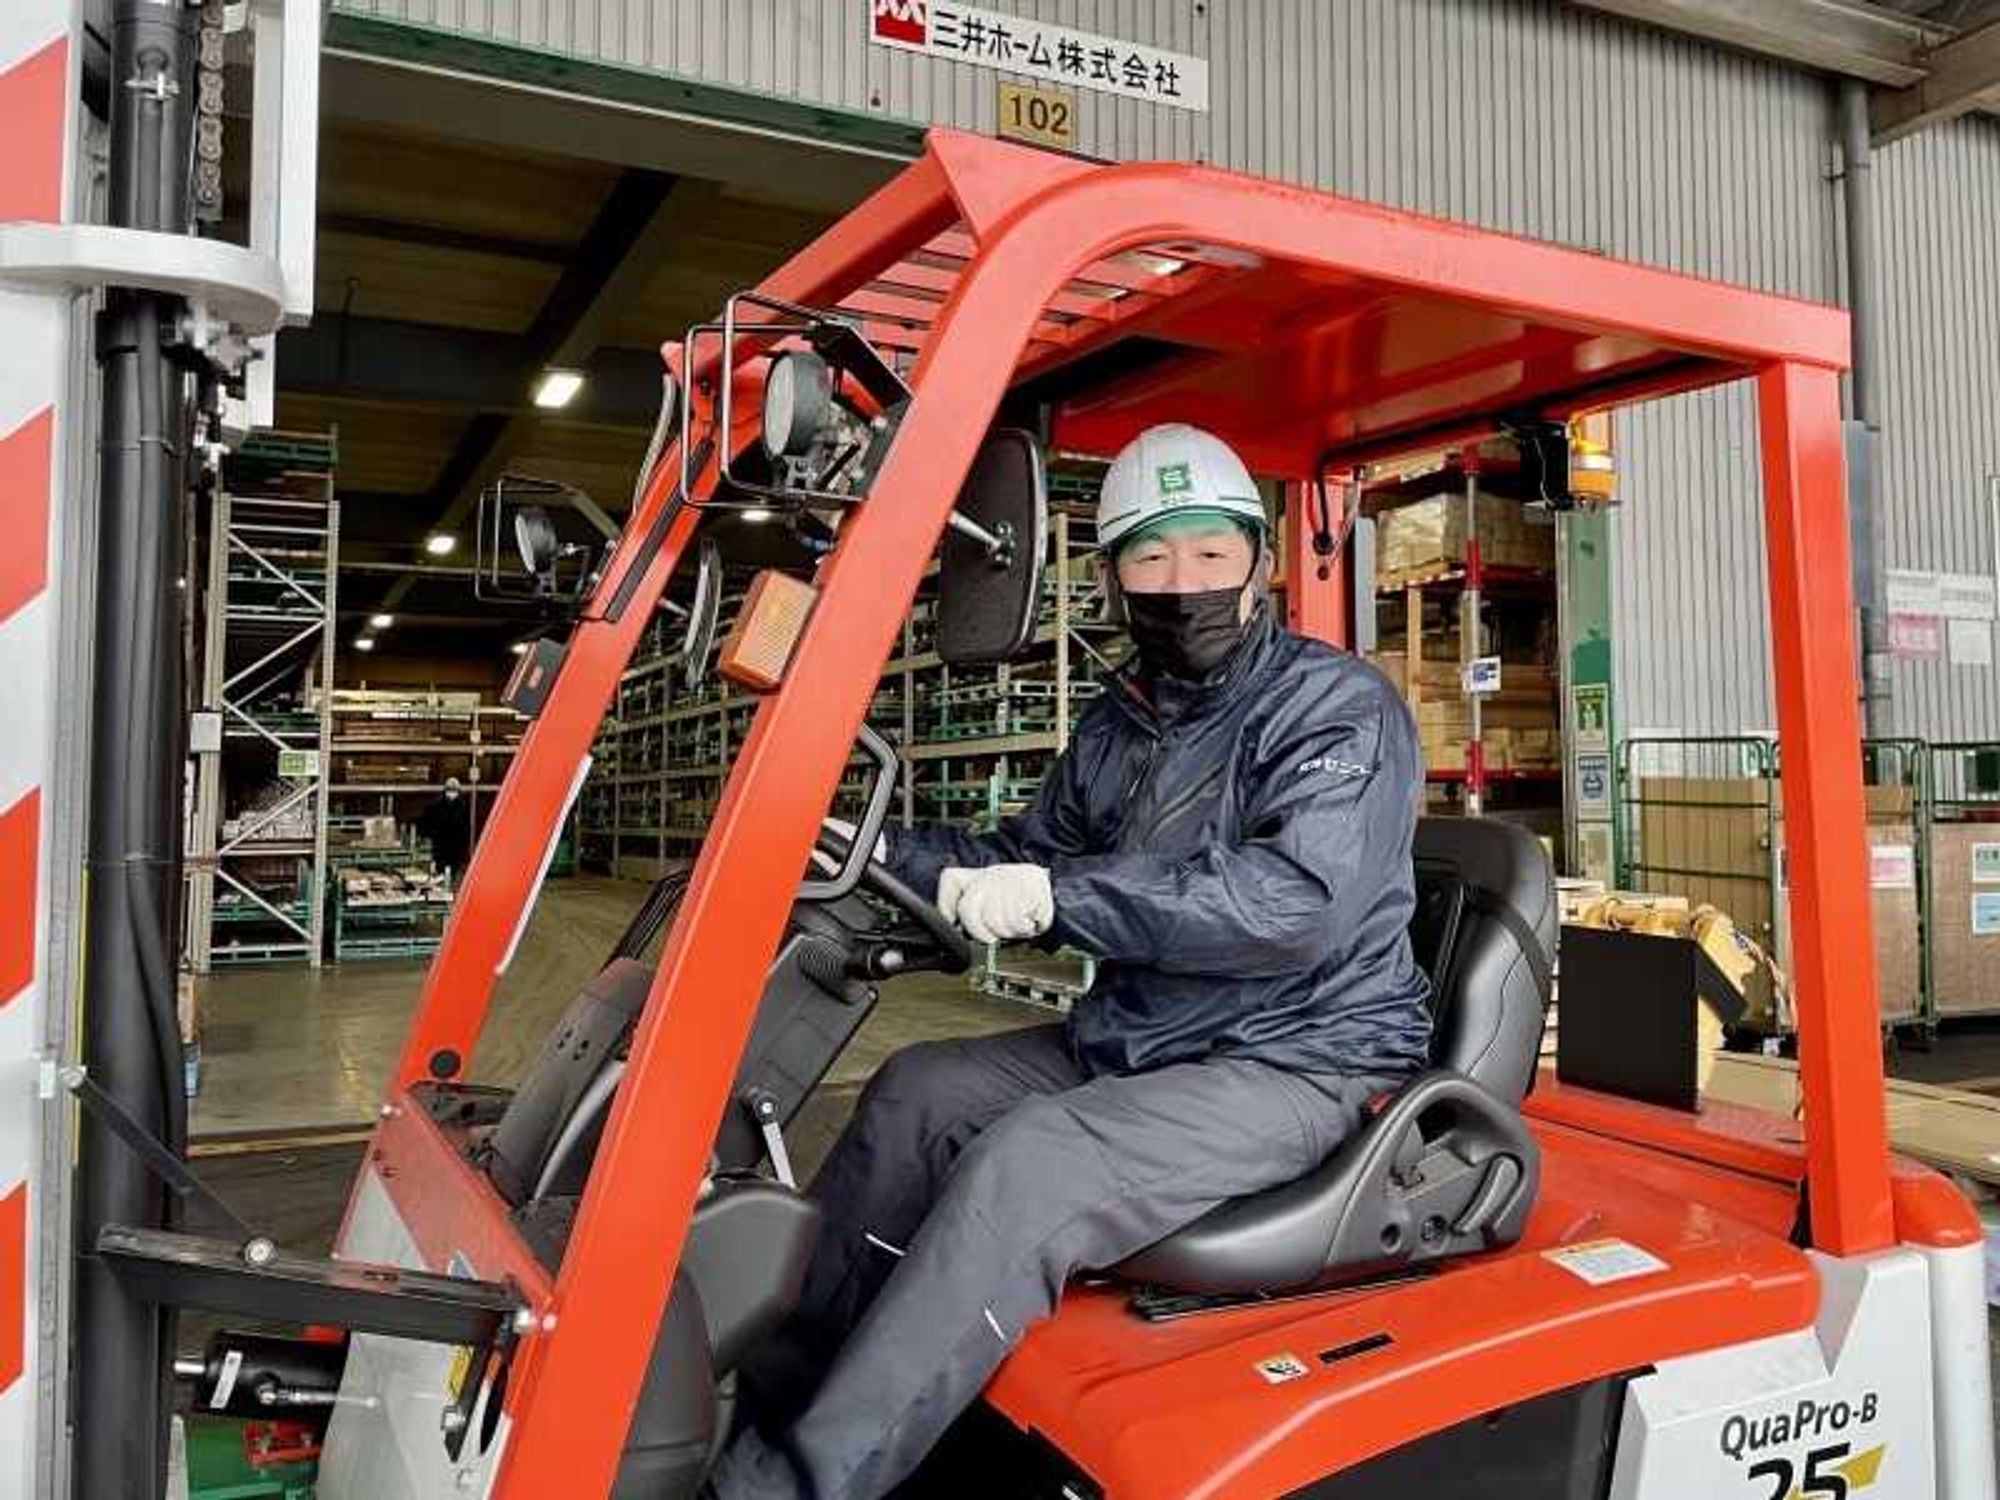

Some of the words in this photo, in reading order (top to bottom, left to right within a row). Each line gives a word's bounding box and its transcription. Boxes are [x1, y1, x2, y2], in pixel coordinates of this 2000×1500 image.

[933, 10, 1181, 97] 三井ホーム株式会社
[1010, 94, 1069, 135] 102
[1720, 1393, 1878, 1461] QuaPro-B
